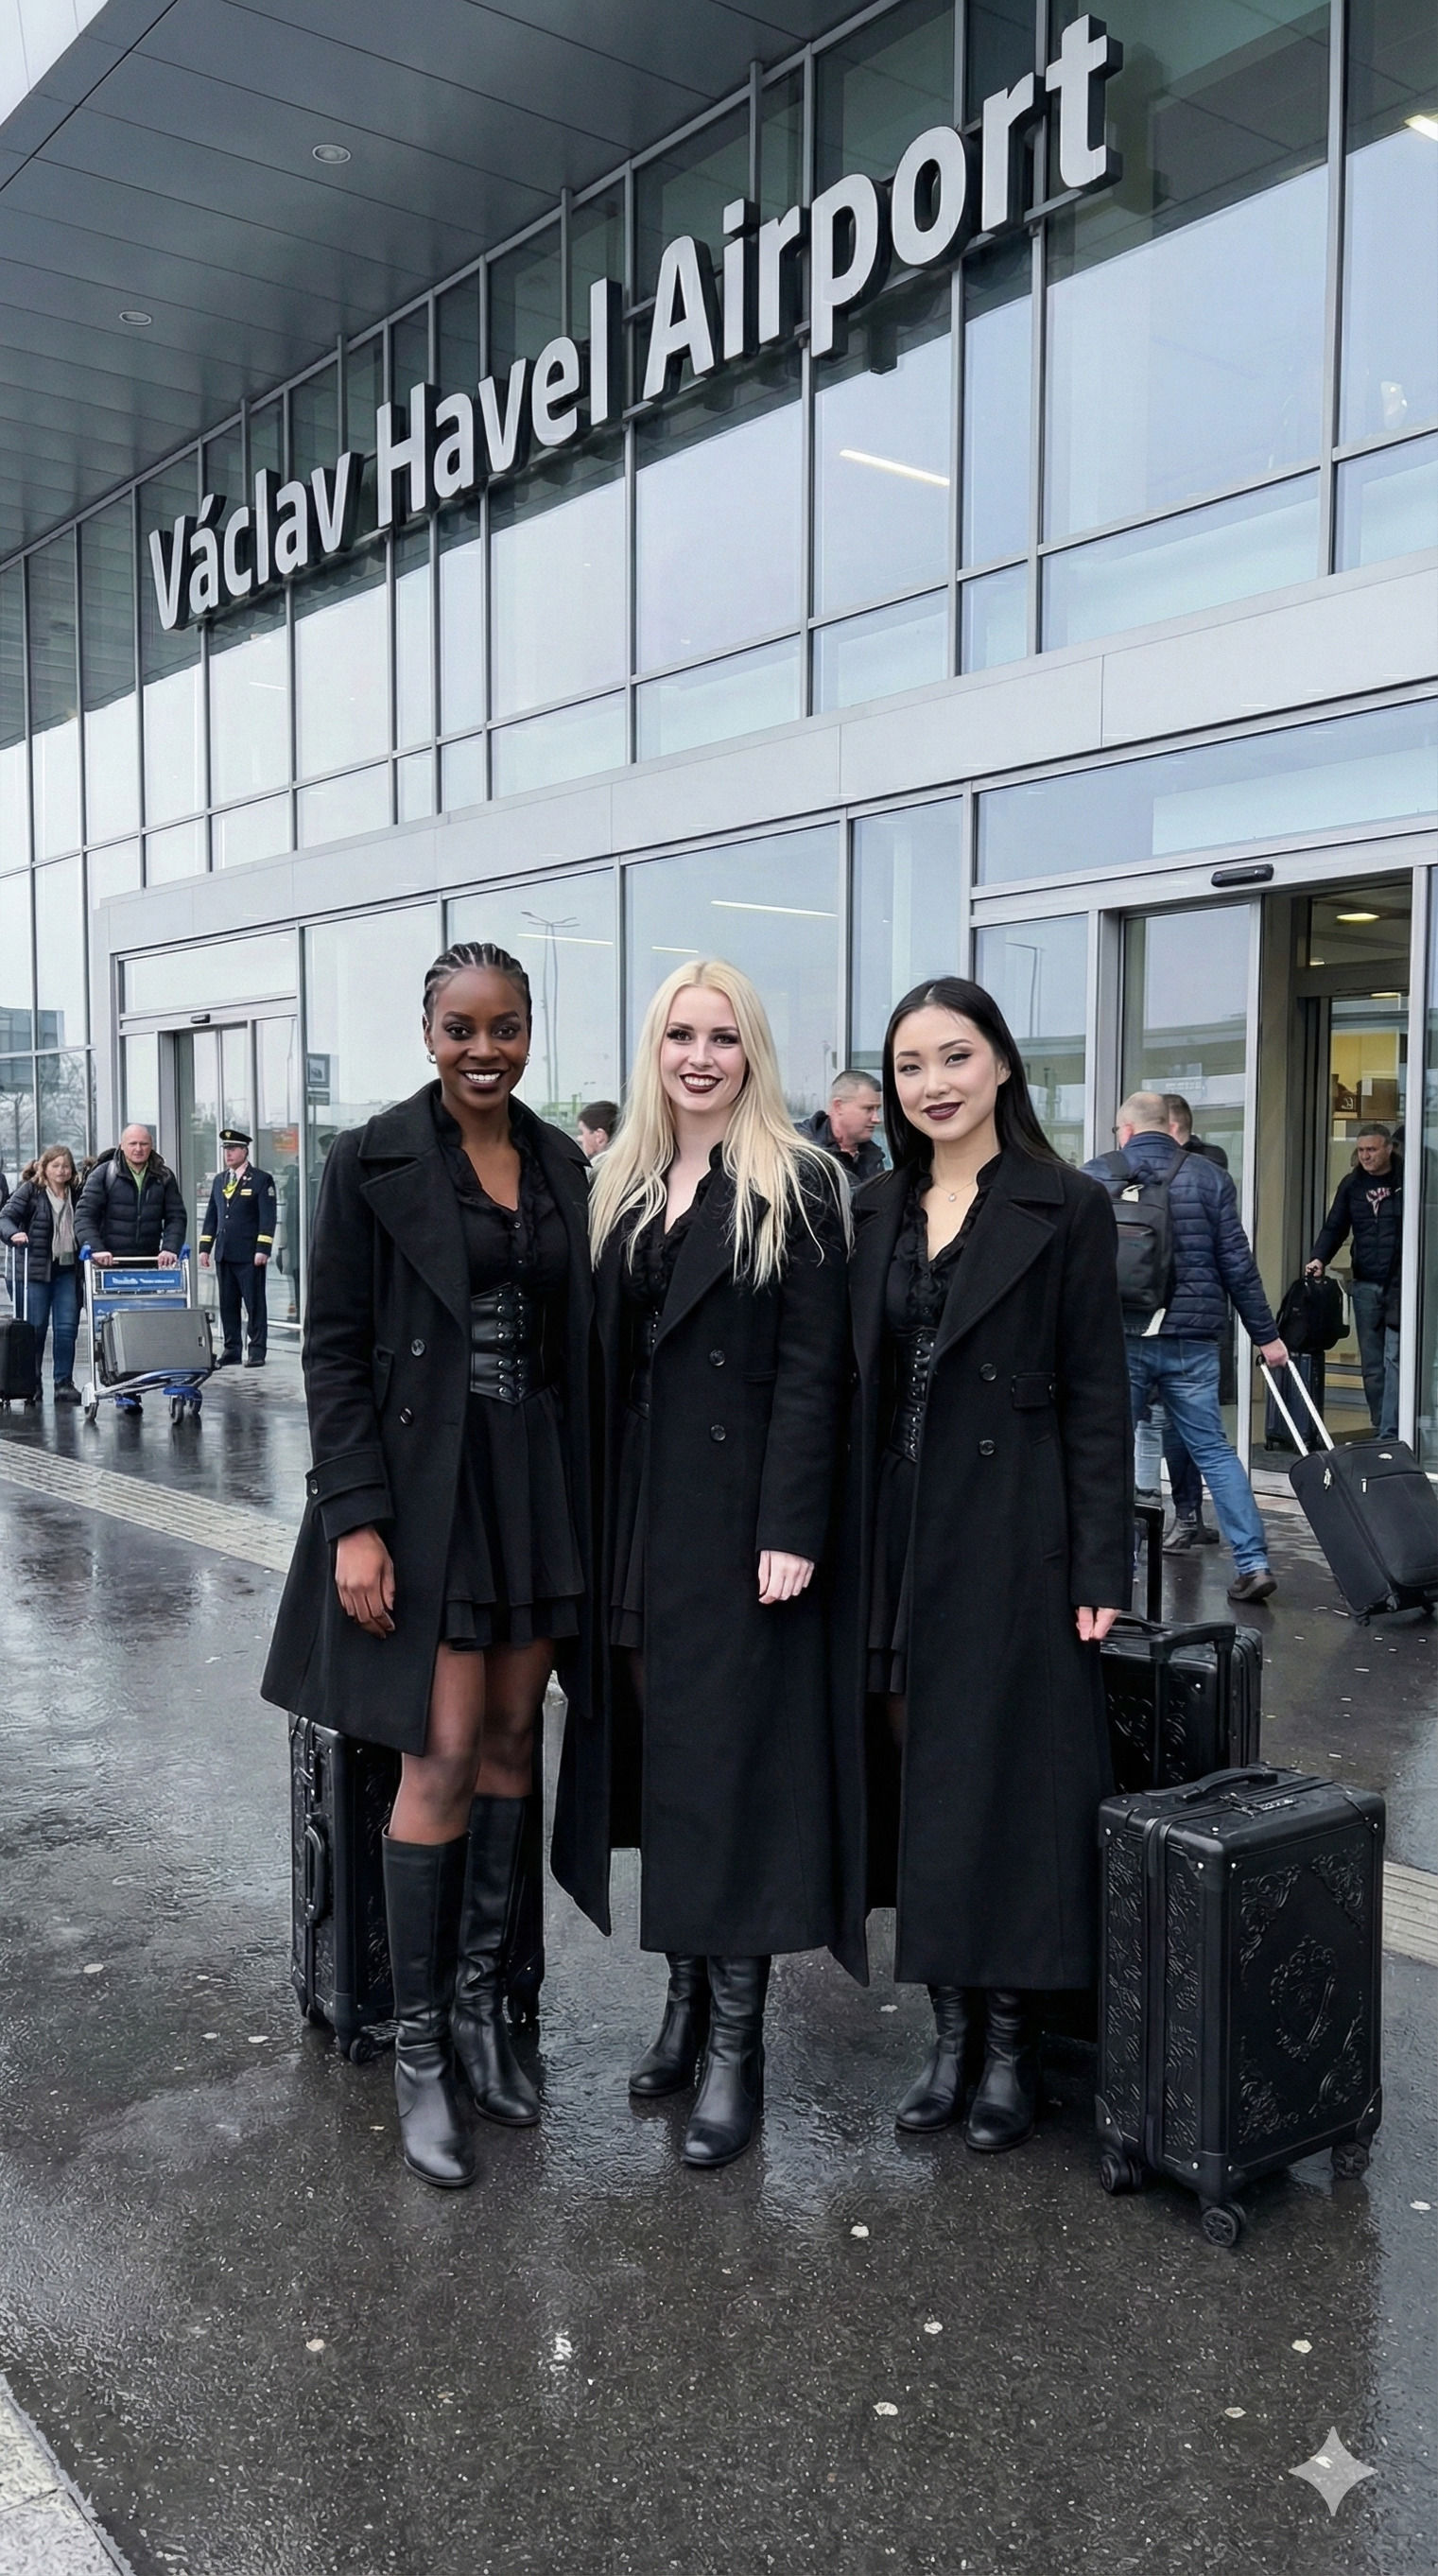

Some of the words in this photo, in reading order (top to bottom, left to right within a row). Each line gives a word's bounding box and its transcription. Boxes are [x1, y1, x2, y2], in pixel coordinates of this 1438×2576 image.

[148, 452, 355, 631] Václav
[376, 279, 615, 529] Havel
[642, 13, 1116, 401] Airport
